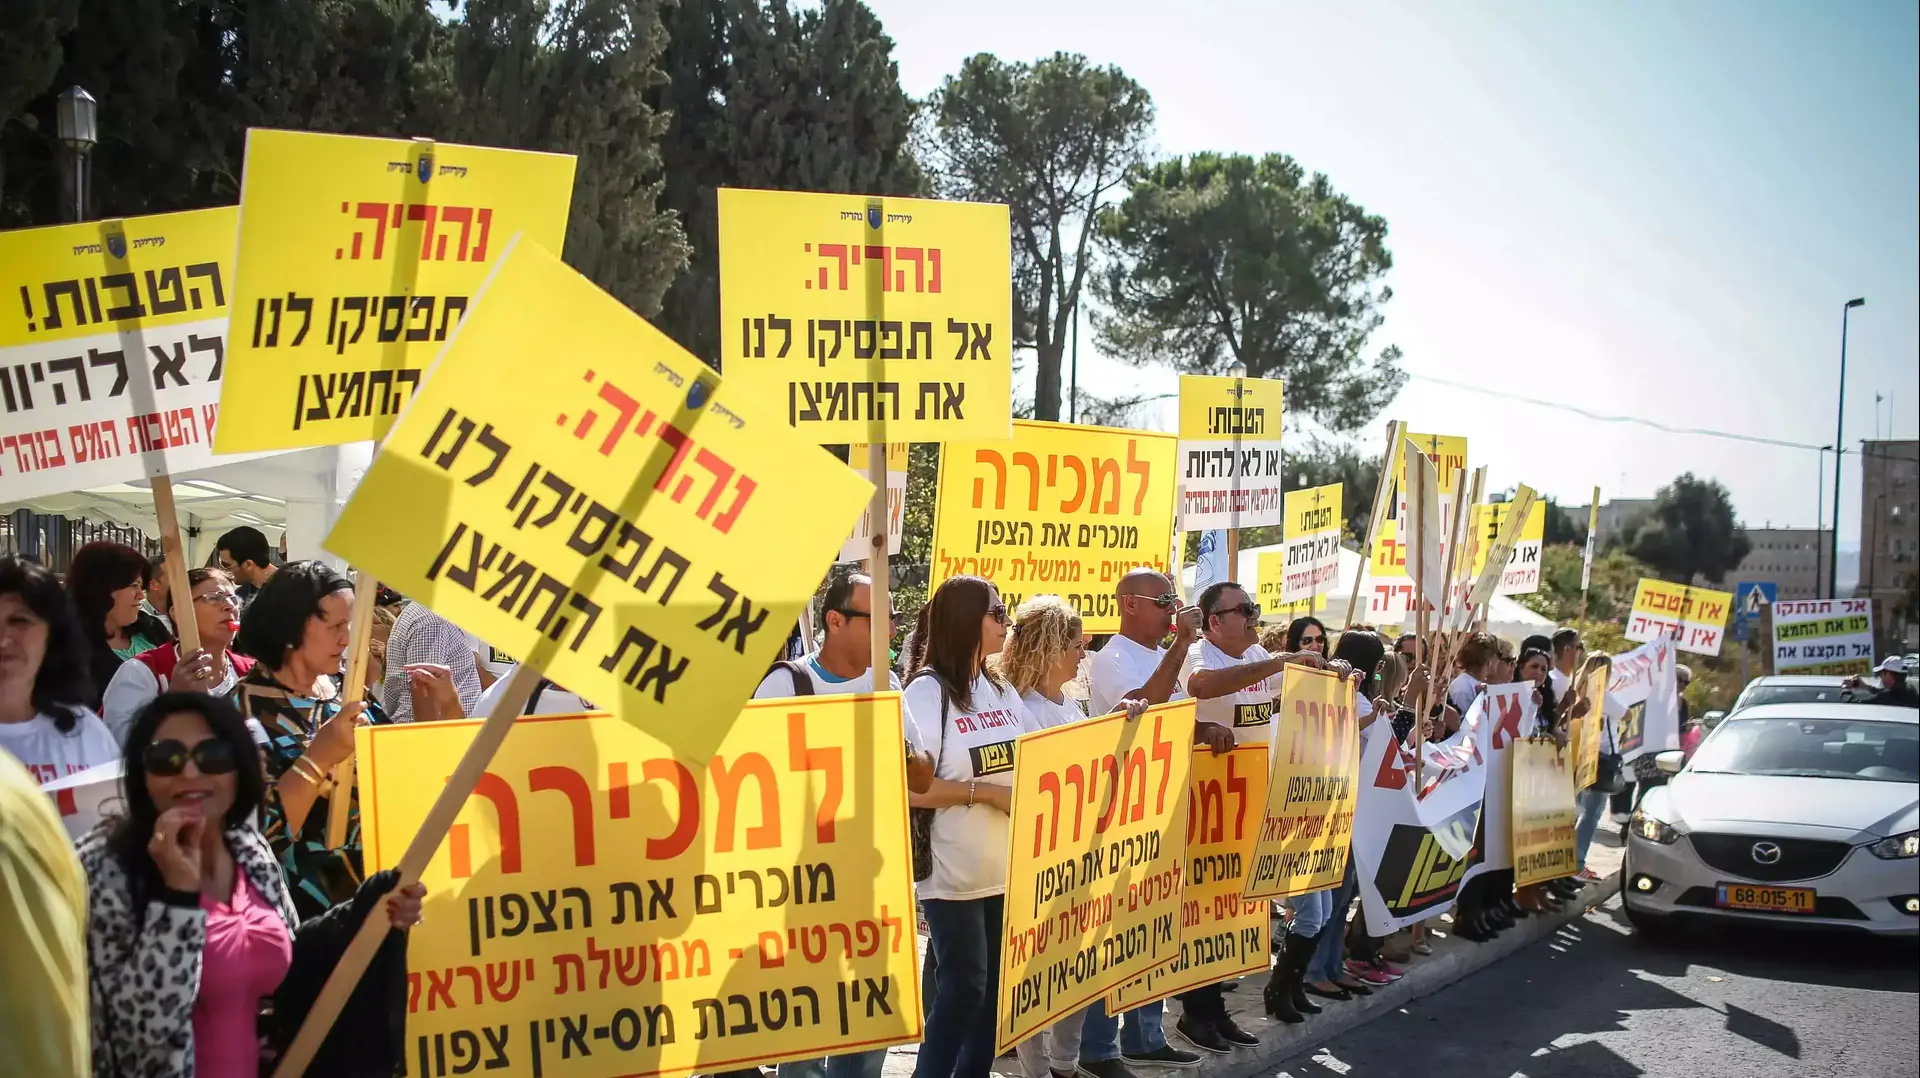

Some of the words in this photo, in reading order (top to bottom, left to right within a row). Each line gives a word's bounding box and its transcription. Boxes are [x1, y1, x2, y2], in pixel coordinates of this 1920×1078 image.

[335, 202, 493, 262] נהריה:
[804, 243, 941, 293] נהריה:
[19, 261, 226, 332] הטבות!
[252, 292, 313, 348] לנו
[326, 296, 468, 355] תפסיקו
[742, 313, 791, 358] לנו
[808, 319, 932, 367] תפסיקו
[947, 317, 992, 360] אל
[0, 348, 129, 413] להיו
[148, 334, 224, 390] לא
[789, 381, 899, 428] החמצן
[915, 382, 965, 420] את
[1208, 407, 1264, 434] הטבות!
[68, 420, 121, 464] המס
[126, 407, 199, 455] הטבות
[420, 407, 512, 487] לנו
[555, 369, 758, 535] נהריה:
[972, 439, 1150, 516] למכירה
[1186, 447, 1235, 478] להיות
[1241, 447, 1261, 477] לא
[1266, 450, 1278, 476] או
[506, 462, 691, 606] תפסיקו
[975, 519, 1033, 553] הצפון
[1040, 522, 1071, 548] את
[1077, 524, 1138, 549] מוכרים
[425, 522, 603, 653] החמצן
[1009, 551, 1081, 582] ממשלת
[695, 572, 770, 655] אל
[1640, 589, 1694, 614] הטבה
[1698, 600, 1722, 620] אין
[1691, 627, 1716, 647] אין
[599, 625, 690, 705] את
[446, 712, 843, 879] למכירה
[1033, 715, 1172, 859] למכירה
[1081, 848, 1104, 886] את
[1109, 829, 1160, 874] מוכרים
[1193, 852, 1241, 885] מוכרים
[609, 877, 677, 924] את
[694, 861, 835, 917] מוכרים
[1033, 858, 1076, 919] הצפון
[1128, 859, 1181, 913] לפרטים
[1735, 888, 1805, 906] 68-015-11
[468, 886, 592, 956] הצפון
[758, 905, 903, 969] לפרטים
[1009, 917, 1053, 969] ישראל
[1058, 891, 1112, 945] ממשלת
[1152, 911, 1173, 959] אין
[553, 936, 711, 994] ממשלת
[1102, 923, 1147, 972] הטבת
[1194, 932, 1235, 966] הטבת
[1241, 926, 1260, 965] אין
[1010, 971, 1042, 1034] צפון
[1047, 945, 1097, 1011] מס-אין
[693, 983, 820, 1041] הטבת
[837, 974, 893, 1036] אין
[418, 1024, 510, 1078] צפון
[529, 1001, 675, 1078] מס-אין
